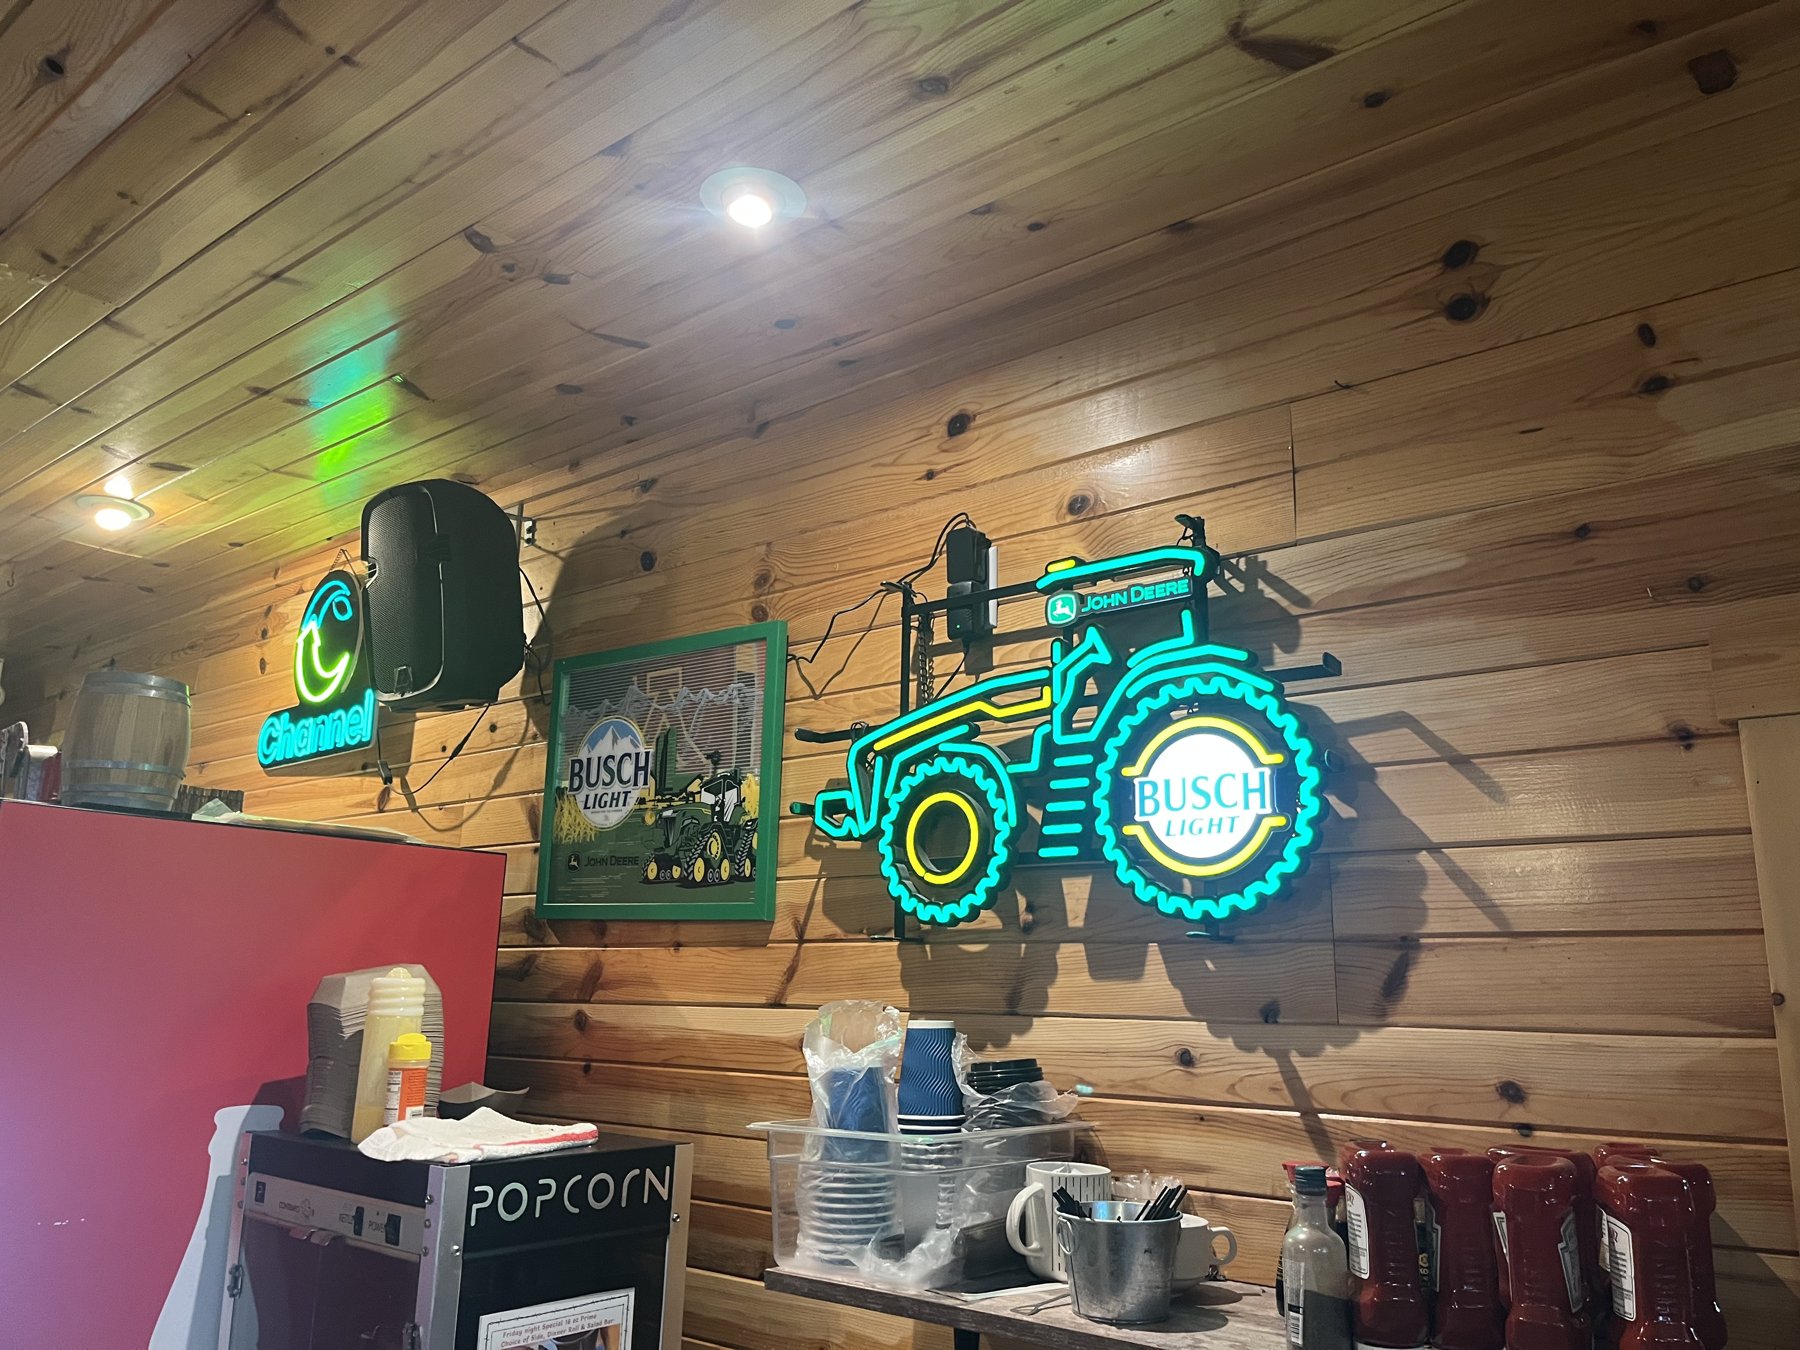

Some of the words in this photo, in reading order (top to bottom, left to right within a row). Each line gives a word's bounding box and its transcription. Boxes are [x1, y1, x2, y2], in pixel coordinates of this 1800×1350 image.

[1081, 590, 1128, 613] JOHN
[1131, 578, 1189, 603] DEERE
[257, 687, 376, 766] Channel
[567, 750, 651, 793] BUSCH
[582, 790, 632, 810] LIGHT
[1137, 769, 1267, 818] BUSCH
[1165, 815, 1240, 837] LIGHT
[583, 855, 609, 867] JOHN
[609, 854, 640, 867] DEERE
[367, 1219, 385, 1233] POWE
[500, 1339, 521, 1348] Choice
[522, 1334, 530, 1343] of
[546, 1329, 567, 1338] Dinner
[587, 1320, 603, 1329] Salad
[603, 1317, 614, 1326] Bar
[502, 1329, 523, 1339] Friday
[542, 1319, 564, 1331] Special
[580, 1313, 597, 1322] Prime
